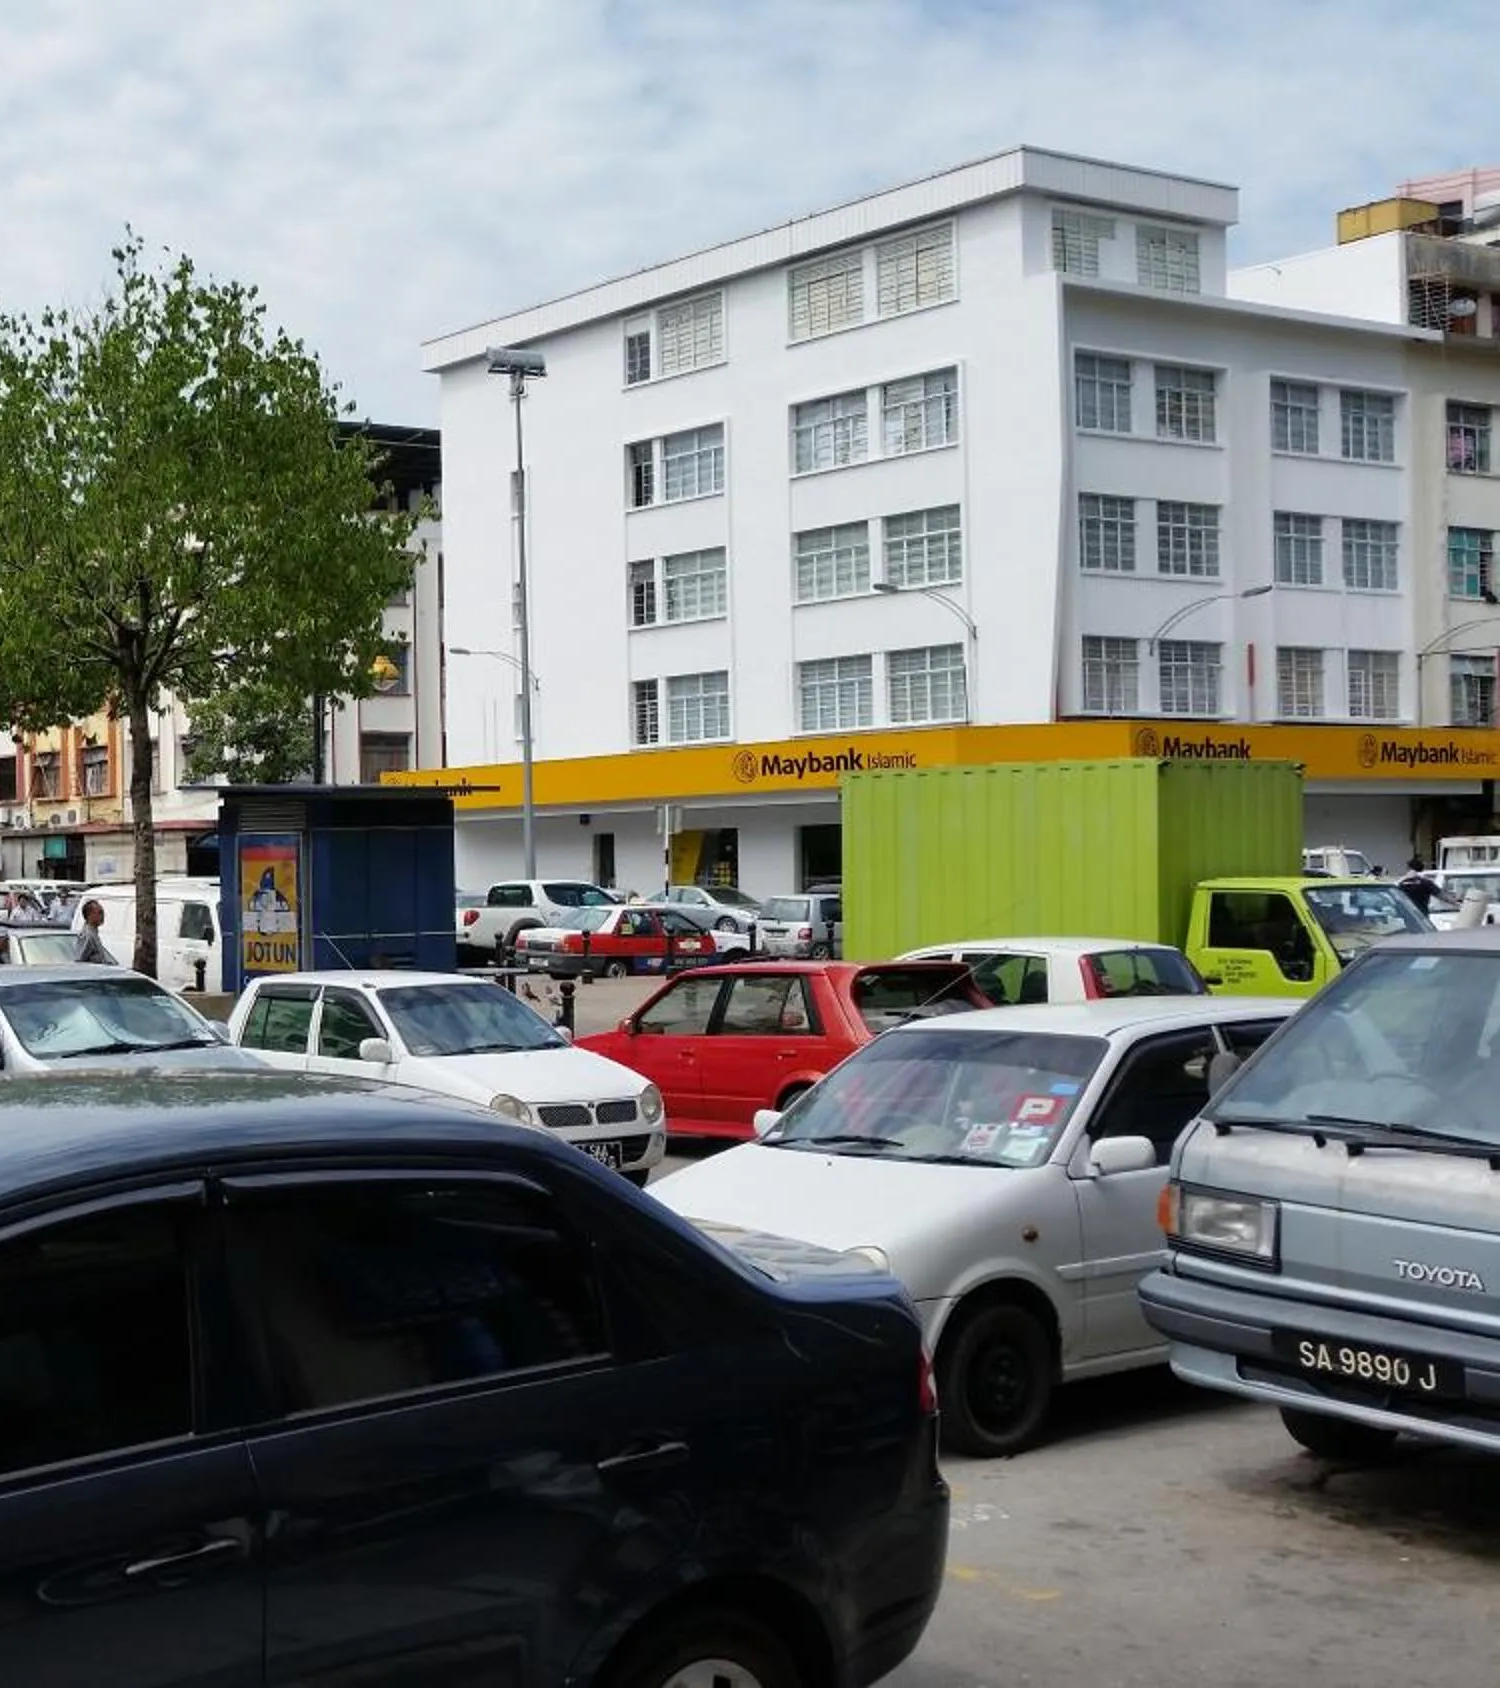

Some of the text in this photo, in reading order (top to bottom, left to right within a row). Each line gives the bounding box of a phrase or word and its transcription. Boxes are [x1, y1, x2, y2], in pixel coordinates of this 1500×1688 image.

[761, 748, 917, 779] Maybank Islamic
[1380, 741, 1459, 768] Maybank
[246, 941, 296, 964] JOTUN
[1393, 1259, 1485, 1292] TOYOTA
[1299, 1341, 1436, 1390] SA 9890 J
